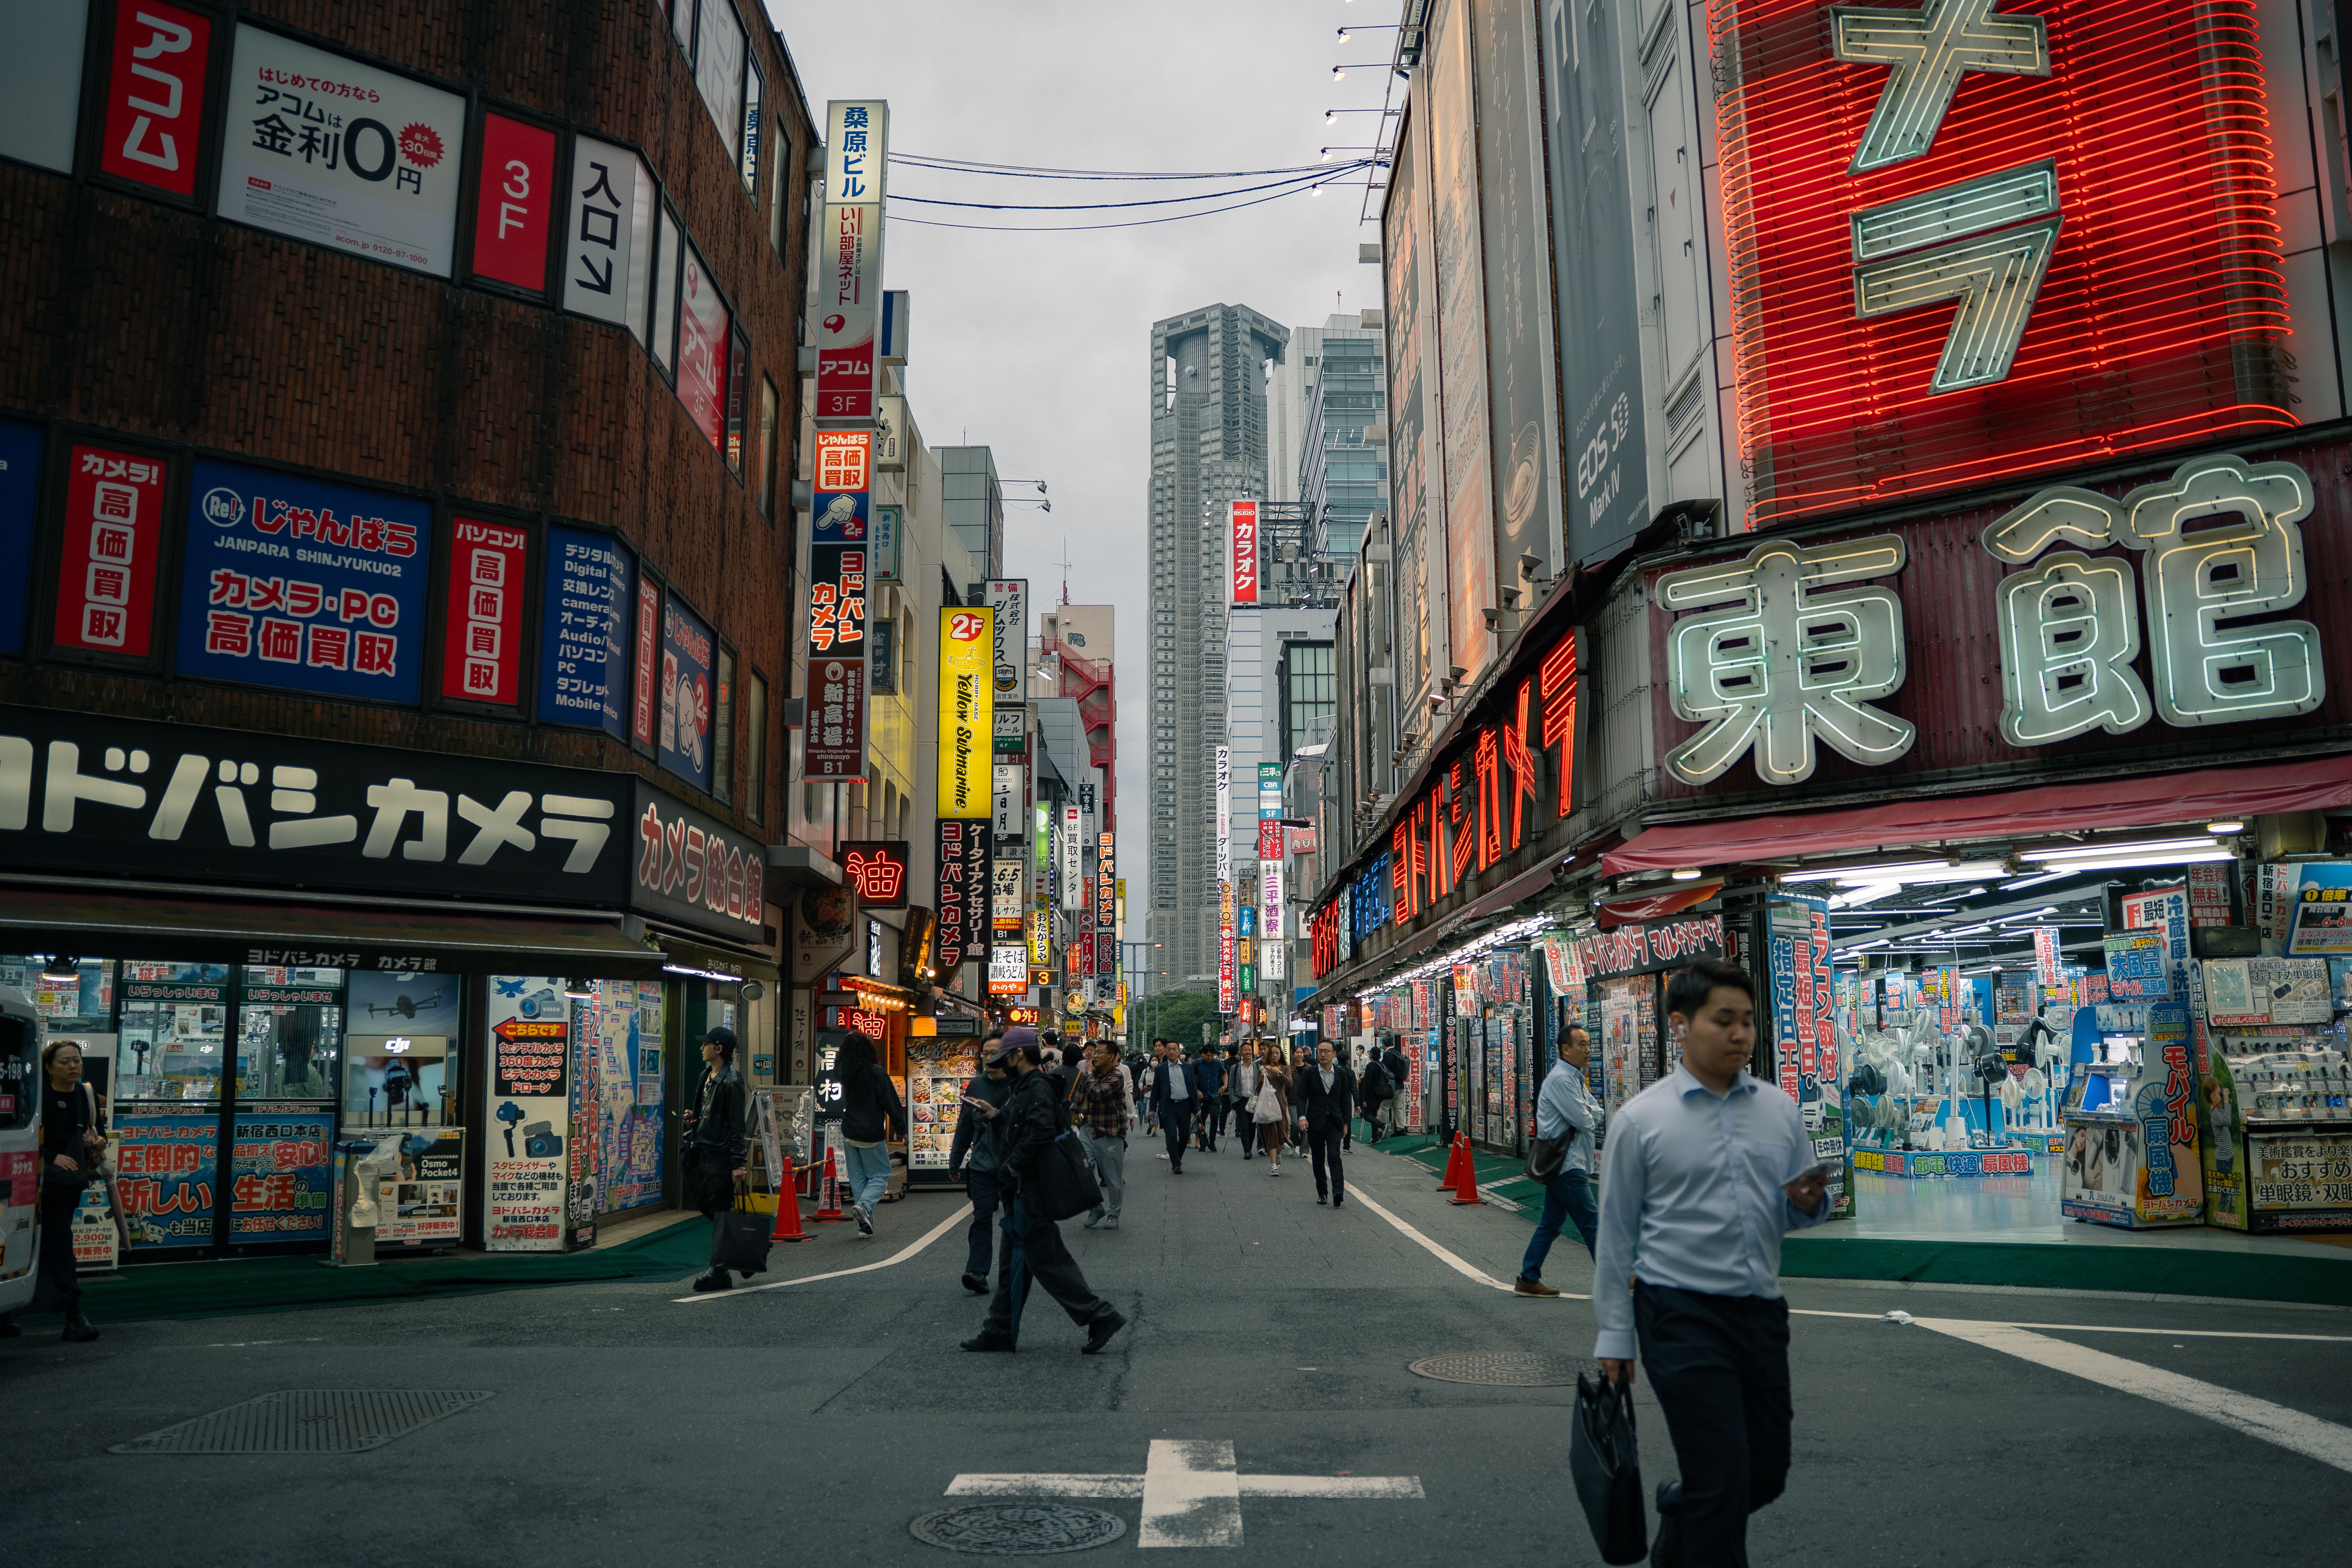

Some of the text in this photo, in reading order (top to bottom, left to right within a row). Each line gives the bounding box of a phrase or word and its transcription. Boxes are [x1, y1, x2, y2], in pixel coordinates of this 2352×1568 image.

[122, 11, 192, 171] アコム
[258, 67, 380, 103] はじめての方なら
[256, 85, 342, 128] アコムは
[414, 133, 429, 143] 最大
[1582, 116, 1595, 153] Canon
[404, 140, 437, 159] 30日間
[842, 107, 868, 197] 桑原ビル
[498, 160, 530, 239] 3F
[580, 161, 622, 250] 入口
[335, 234, 427, 264] acom.jp 0120-07-1000
[839, 207, 855, 305] いい部屋ネット
[821, 361, 869, 375] アコム
[832, 396, 856, 412] 3F
[819, 434, 867, 445] じゃんぱら
[1578, 392, 1629, 499] EOS 5D
[82, 454, 158, 485] カメラ!
[825, 451, 861, 467] 高価
[825, 470, 860, 486] 買取
[1590, 463, 1621, 528] Mark IV
[252, 497, 416, 558] じゃんぱら
[456, 523, 525, 549] パソコン!
[845, 522, 862, 537] 2F
[88, 488, 132, 639] 高価買取
[214, 536, 402, 577] JANPARA SHINJYUKU02
[565, 543, 623, 574] デジタルカメラ
[1236, 523, 1254, 590] カラオケ
[209, 568, 399, 628] カメラ・PC
[562, 579, 614, 600] 交換レンズ
[838, 552, 864, 643] ヨドバシ
[994, 583, 1018, 592] 警備
[811, 582, 835, 650] カメラ
[1009, 594, 1020, 625] 株式会社
[1655, 454, 2326, 785] 東館
[468, 555, 502, 691] 高価買取
[561, 612, 613, 634] オーディオ
[951, 615, 984, 640] 2F
[205, 610, 397, 677] 高価買取
[674, 612, 710, 670] じゃんぱら
[558, 645, 607, 663] パソコン
[558, 660, 576, 673] PC
[557, 677, 609, 696] タブレット
[847, 670, 855, 743] 新宿自家製らーめん
[810, 710, 819, 743] 新宿本店
[954, 673, 973, 810] Yellow Submarine
[1217, 749, 1229, 790] カラオケ
[1392, 627, 1576, 927] ヨドバシカメラ
[1083, 795, 1091, 813] 吉永
[639, 802, 762, 925] カメラ総合館
[1067, 833, 1078, 905] 買取センター
[1218, 838, 1229, 878] ダーツバー
[847, 851, 902, 898] 油
[1099, 833, 1114, 926] ヨドバシカメラ
[2190, 866, 2227, 884] 年会費
[940, 823, 962, 966] ヨドバシカメラ
[967, 824, 985, 956] ケータイアクセサリー館
[2322, 890, 2347, 901] 倍率
[2144, 899, 2165, 922] 最短
[2193, 907, 2230, 918] 新規会員
[1037, 912, 1047, 962] おたからや
[248, 949, 436, 970] ヨドバシカメラ カメラ館
[992, 950, 1024, 963] 生そば
[1083, 934, 1091, 974] らーめん
[1100, 935, 1113, 974] 時計館
[2043, 935, 2054, 984] 本日お届け・設置
[2110, 949, 2161, 979] 大風量
[2252, 961, 2321, 970] 美術鑑賞をより楽しむ
[991, 966, 1024, 979] 讃岐うどん
[1511, 952, 1520, 1002] エアコン取付
[1941, 969, 1949, 999] 上下左右
[2255, 970, 2323, 981] おすすめ単眼鏡
[128, 985, 218, 999] いらっしゃいませ
[249, 989, 332, 1002] いらっしゃいませ
[992, 983, 1017, 992] かのや
[1810, 910, 1837, 1084] エアコン取付
[2111, 979, 2168, 997] モバイル扇風機
[1774, 937, 1800, 1105] 指定日工事
[2150, 1009, 2185, 1023] 大風量
[506, 1024, 560, 1036] こちらです
[2261, 1027, 2304, 1036] 双眼鏡売場
[499, 1043, 563, 1054] ウェアラブルカメラ
[1447, 1027, 1456, 1089] マルチメディア館
[2196, 1020, 2209, 1074] 双眼鏡
[500, 1056, 563, 1068] 360度カメラ
[502, 1068, 560, 1080] ビデオカメラ
[511, 1082, 550, 1093] ドローン
[1410, 1046, 1420, 1126] 本日お届け・設置
[2164, 1045, 2194, 1143] モバイル
[1448, 1093, 1456, 1108] 南館
[124, 1126, 216, 1139] ヨドバシカメラ
[236, 1125, 321, 1139] 新宿西口本店
[1450, 1117, 1456, 1129] です
[234, 1143, 272, 1157] 品揃え
[1816, 1138, 1843, 1155] 年中無休
[2145, 1117, 2174, 1197] 扇風機
[117, 1144, 216, 1173] 圧倒的な
[234, 1159, 273, 1169] から選べて
[421, 1160, 447, 1168] Osmo
[493, 1161, 556, 1170] スタビライザーや
[1855, 1151, 1905, 1175] 最新高性能 扇風機
[2281, 1161, 2351, 1179] おすすめ
[421, 1168, 458, 1177] Pocket4
[493, 1171, 563, 1181] マイクなどの機材も
[116, 1177, 211, 1214] 新しい
[493, 1182, 558, 1192] 当館で各種ご用意
[493, 1192, 541, 1202] しております。
[2096, 1193, 2116, 1203] JisuLife
[492, 1206, 559, 1215] ヨドバシカメラ
[2143, 1198, 2198, 1209] ヨドバシカメラ
[229, 1215, 322, 1232] にお任せください!
[2075, 1210, 2110, 1221] モバイル扇風機
[169, 1218, 213, 1237] も当店
[492, 1225, 558, 1239] カメラ総合館
